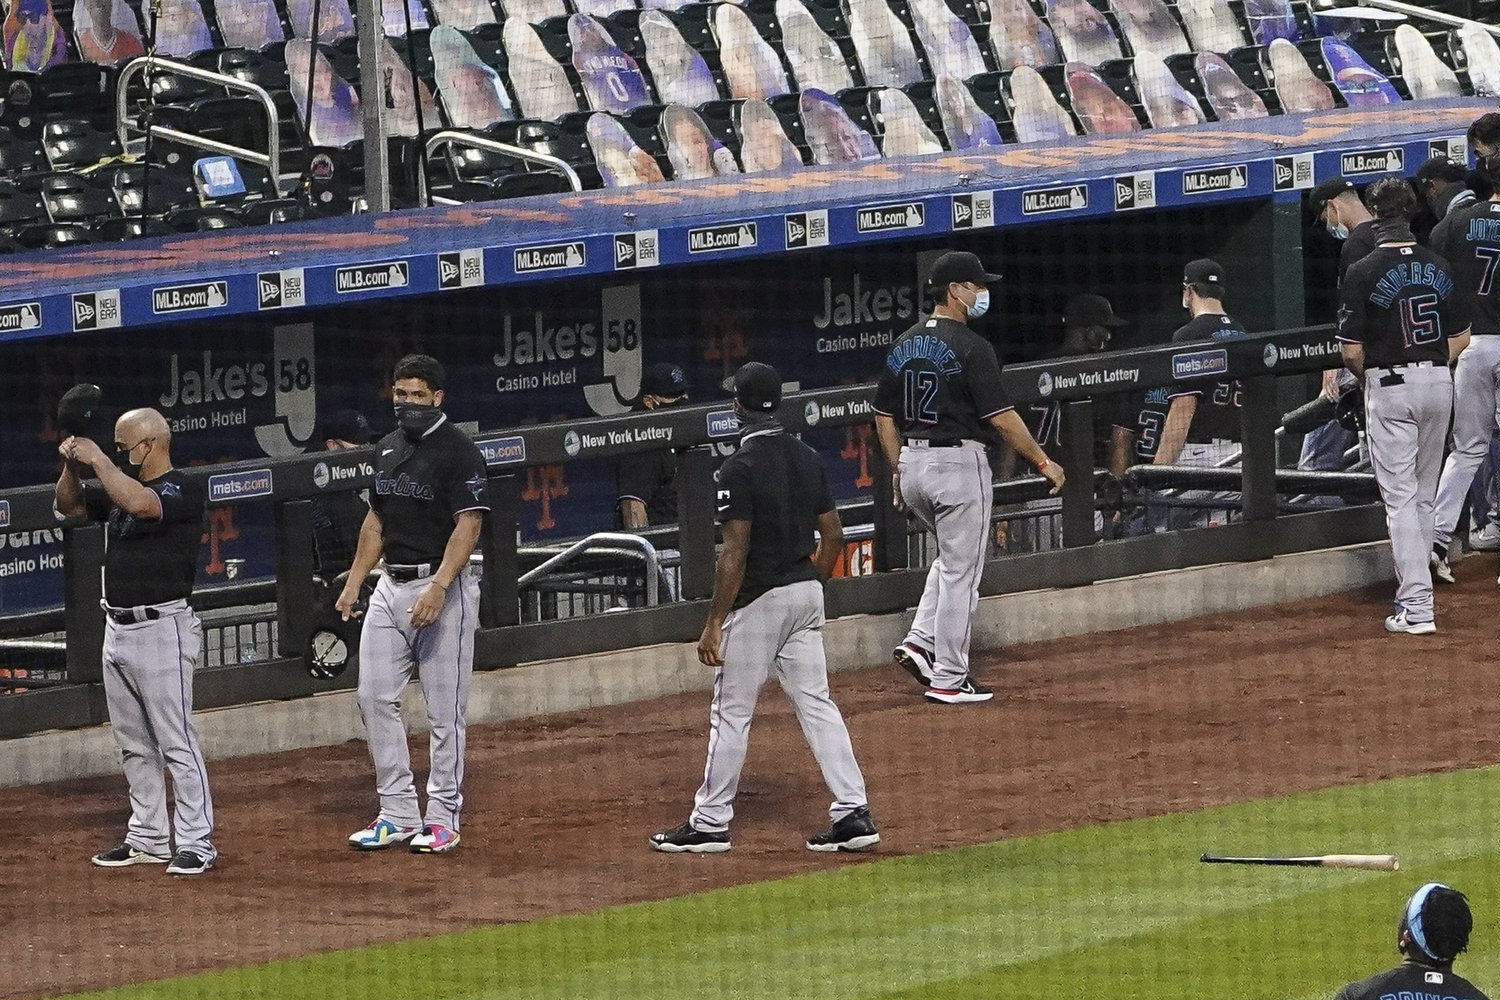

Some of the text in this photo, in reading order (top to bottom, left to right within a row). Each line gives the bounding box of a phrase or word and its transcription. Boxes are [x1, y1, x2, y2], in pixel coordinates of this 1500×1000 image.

[1297, 161, 1311, 172] NEW
[1344, 155, 1386, 172] MLB.com
[1137, 180, 1151, 191] NEW
[1186, 173, 1229, 191] MLB.com
[976, 199, 990, 210] NEW
[1025, 192, 1069, 211] MLB.com
[810, 218, 825, 229] NEW
[860, 211, 905, 229] MLB.com
[976, 209, 991, 220] ERA
[691, 231, 737, 250] MLB.com
[810, 228, 826, 238] ERA
[639, 237, 654, 249] NEW
[517, 250, 565, 268] MLB.com
[639, 248, 655, 259] ERA
[464, 257, 479, 269] NEW
[284, 276, 300, 288] NEW
[339, 269, 388, 289] MLB.com
[464, 268, 480, 278] ERA
[285, 287, 301, 298] ERA
[1369, 262, 1454, 309] ANDERSON
[100, 298, 117, 310] NEW
[156, 289, 206, 308] MLB.com
[813, 273, 912, 329] Jake's
[100, 309, 117, 320] ERA
[1399, 293, 1441, 348] 15
[493, 311, 638, 368] Jake's 58
[816, 329, 893, 353] Casino Hotel
[1280, 347, 1301, 360] New
[1303, 343, 1325, 357] York
[1176, 357, 1225, 373] mets.com
[159, 350, 311, 408] Jake's 58
[496, 368, 577, 392] Casino Hotel
[1055, 368, 1139, 389] New York Lottery
[904, 369, 938, 424] 12
[211, 408, 247, 428] Hotel
[821, 400, 872, 418] New York
[582, 426, 673, 448] New York Lottery
[332, 465, 356, 481] New
[213, 479, 269, 495] mets.com
[0, 553, 64, 577] asino Hot
